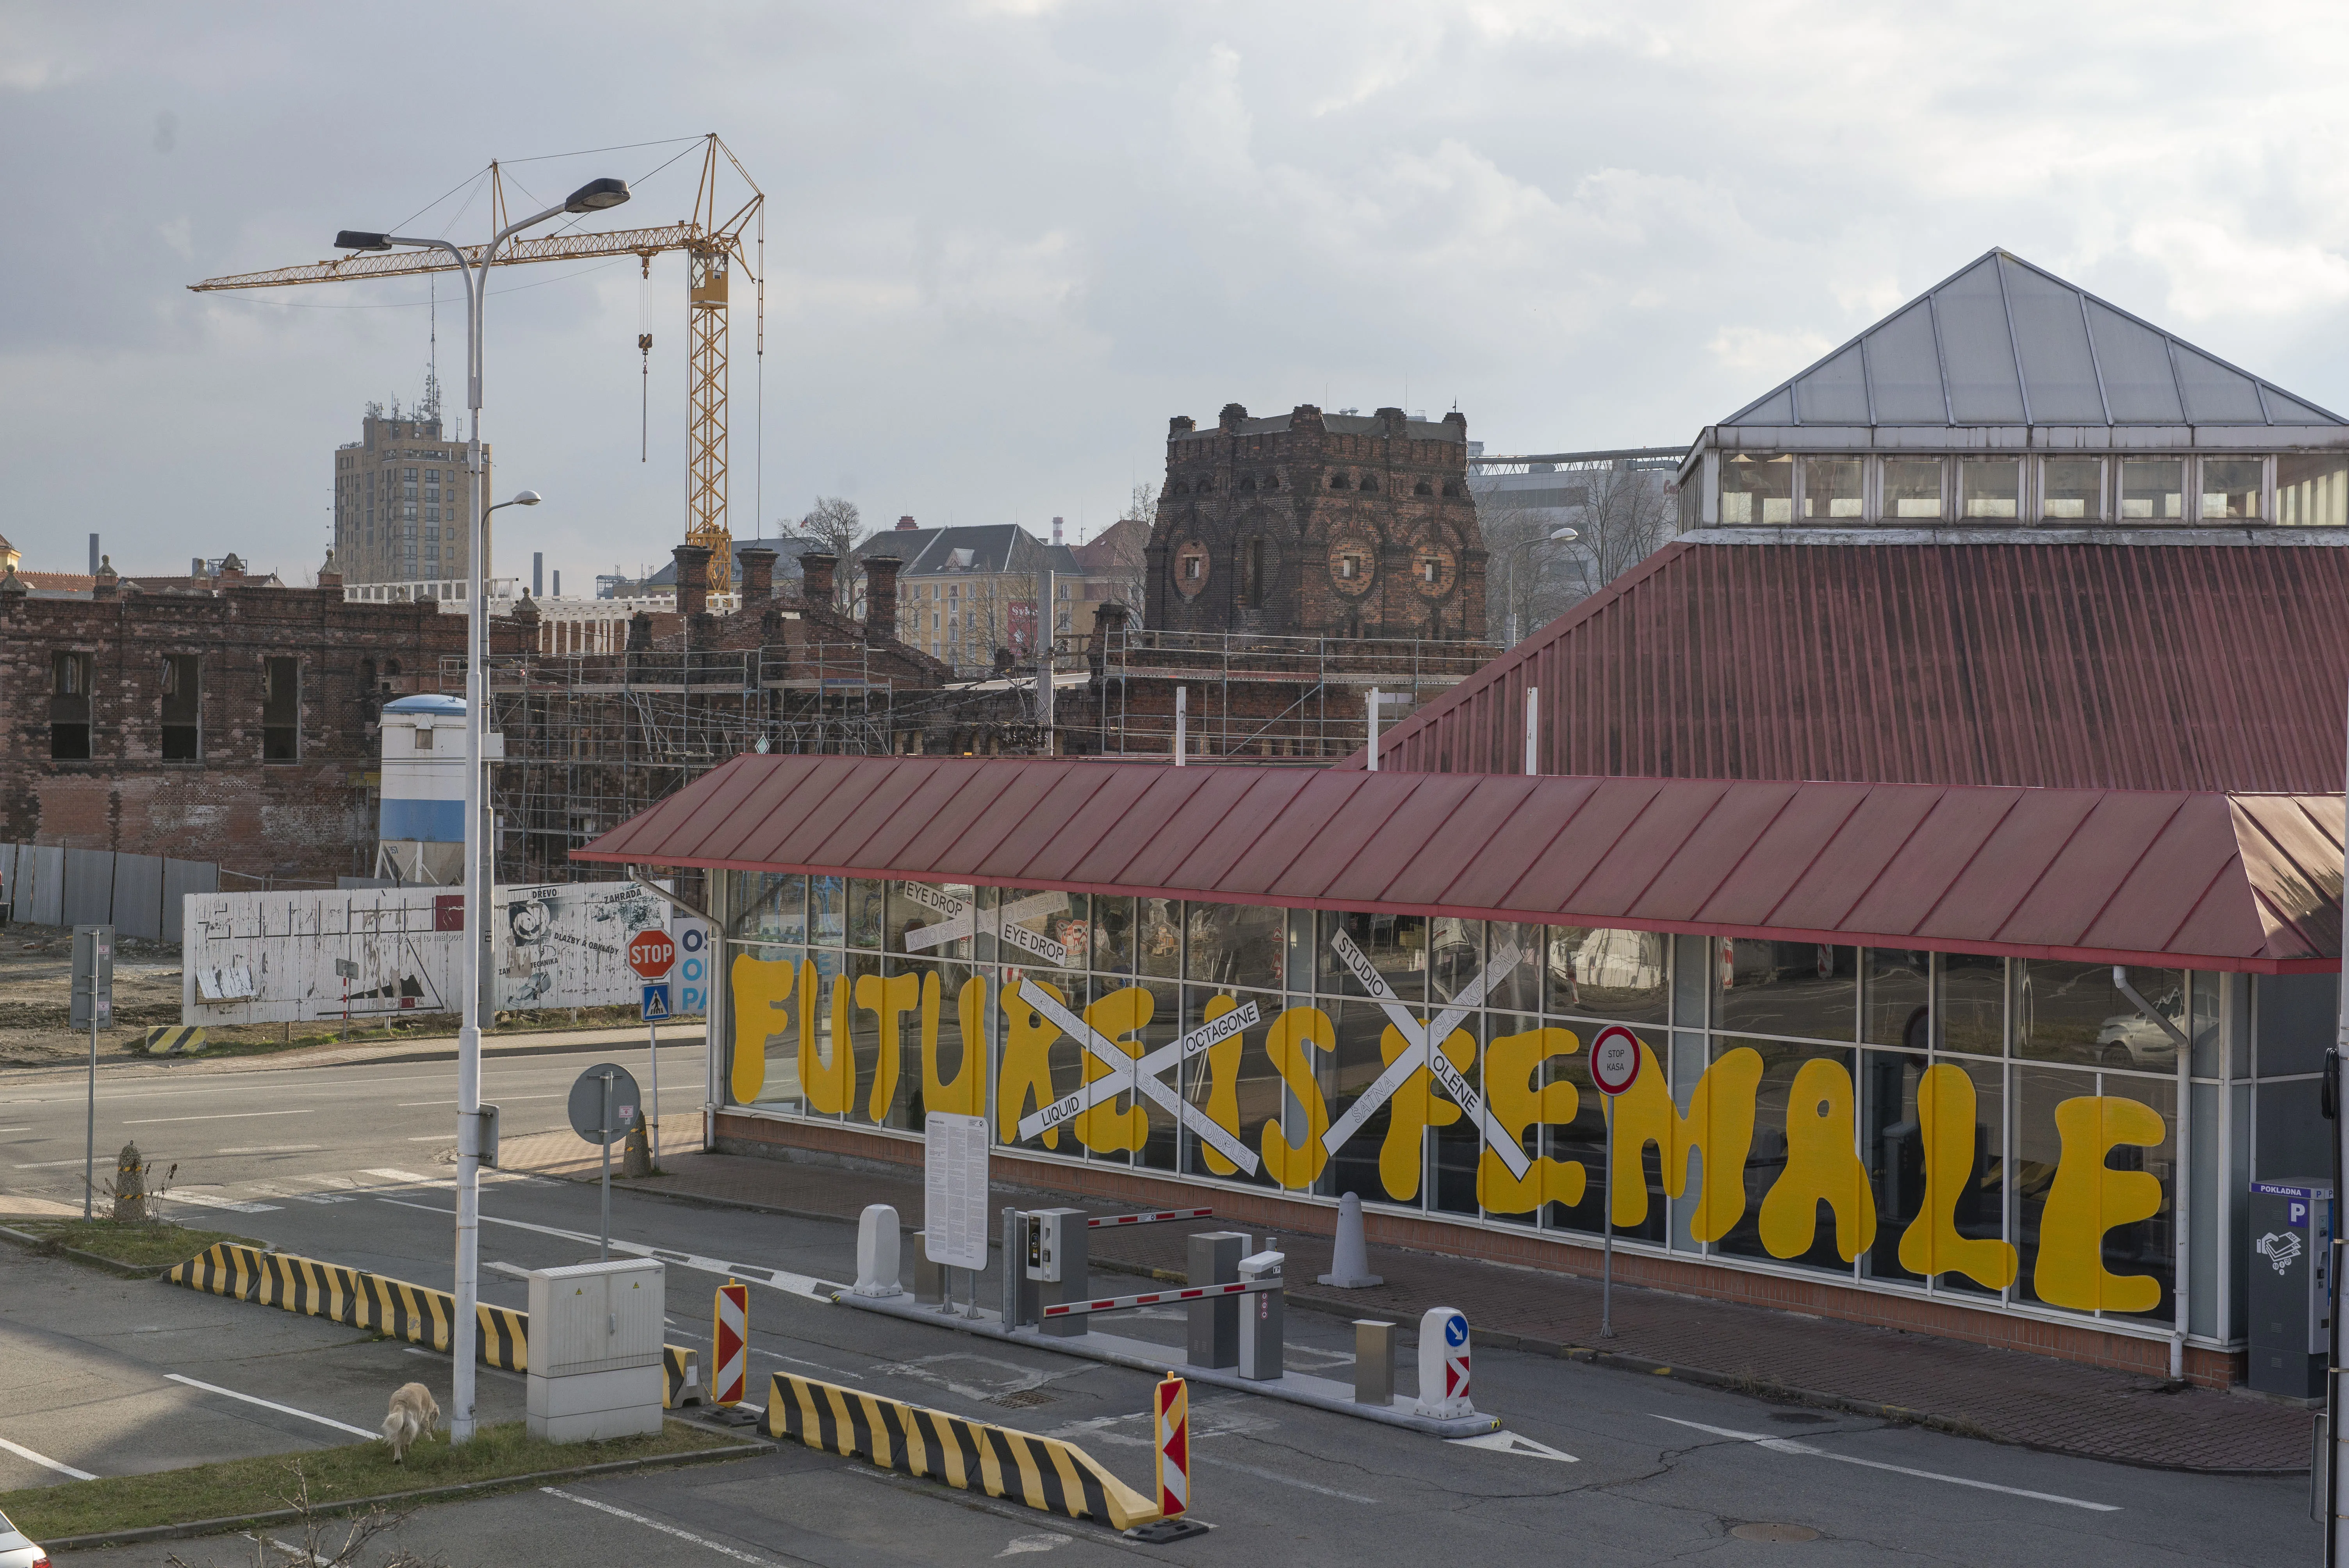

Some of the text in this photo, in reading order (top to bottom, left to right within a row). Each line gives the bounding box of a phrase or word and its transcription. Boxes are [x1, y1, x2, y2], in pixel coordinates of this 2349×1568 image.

[532, 888, 557, 899] DŘEVO
[604, 888, 642, 904] ZAHRADA
[907, 882, 962, 916] EYE DROP
[909, 928, 937, 948] KINO
[939, 916, 984, 940] CINEMA
[1017, 893, 1064, 918] CINEMA
[424, 934, 431, 942] to
[554, 933, 581, 945] DLAŽBY
[589, 942, 619, 955] OBKLADY
[682, 929, 708, 952] O
[1004, 924, 1064, 960] EYE DROP
[531, 958, 558, 969] TECHNIKA
[632, 944, 672, 963] STOP
[1339, 937, 1383, 995] STUDIO
[682, 958, 707, 981] O
[1433, 948, 1516, 1037] CLOAKROOM
[1186, 1005, 1256, 1052] OCTAGONE
[1022, 981, 1067, 1025] DISPLEJ
[1204, 1122, 1254, 1169] DISPLEJ
[1041, 1097, 1079, 1126] LIQUID
[1350, 1076, 1395, 1123] ŠATNA
[731, 953, 2162, 1312] FUTURE IS FEMALE
[2261, 1185, 2301, 1196] POKLADNA
[2291, 1203, 2305, 1222] P
